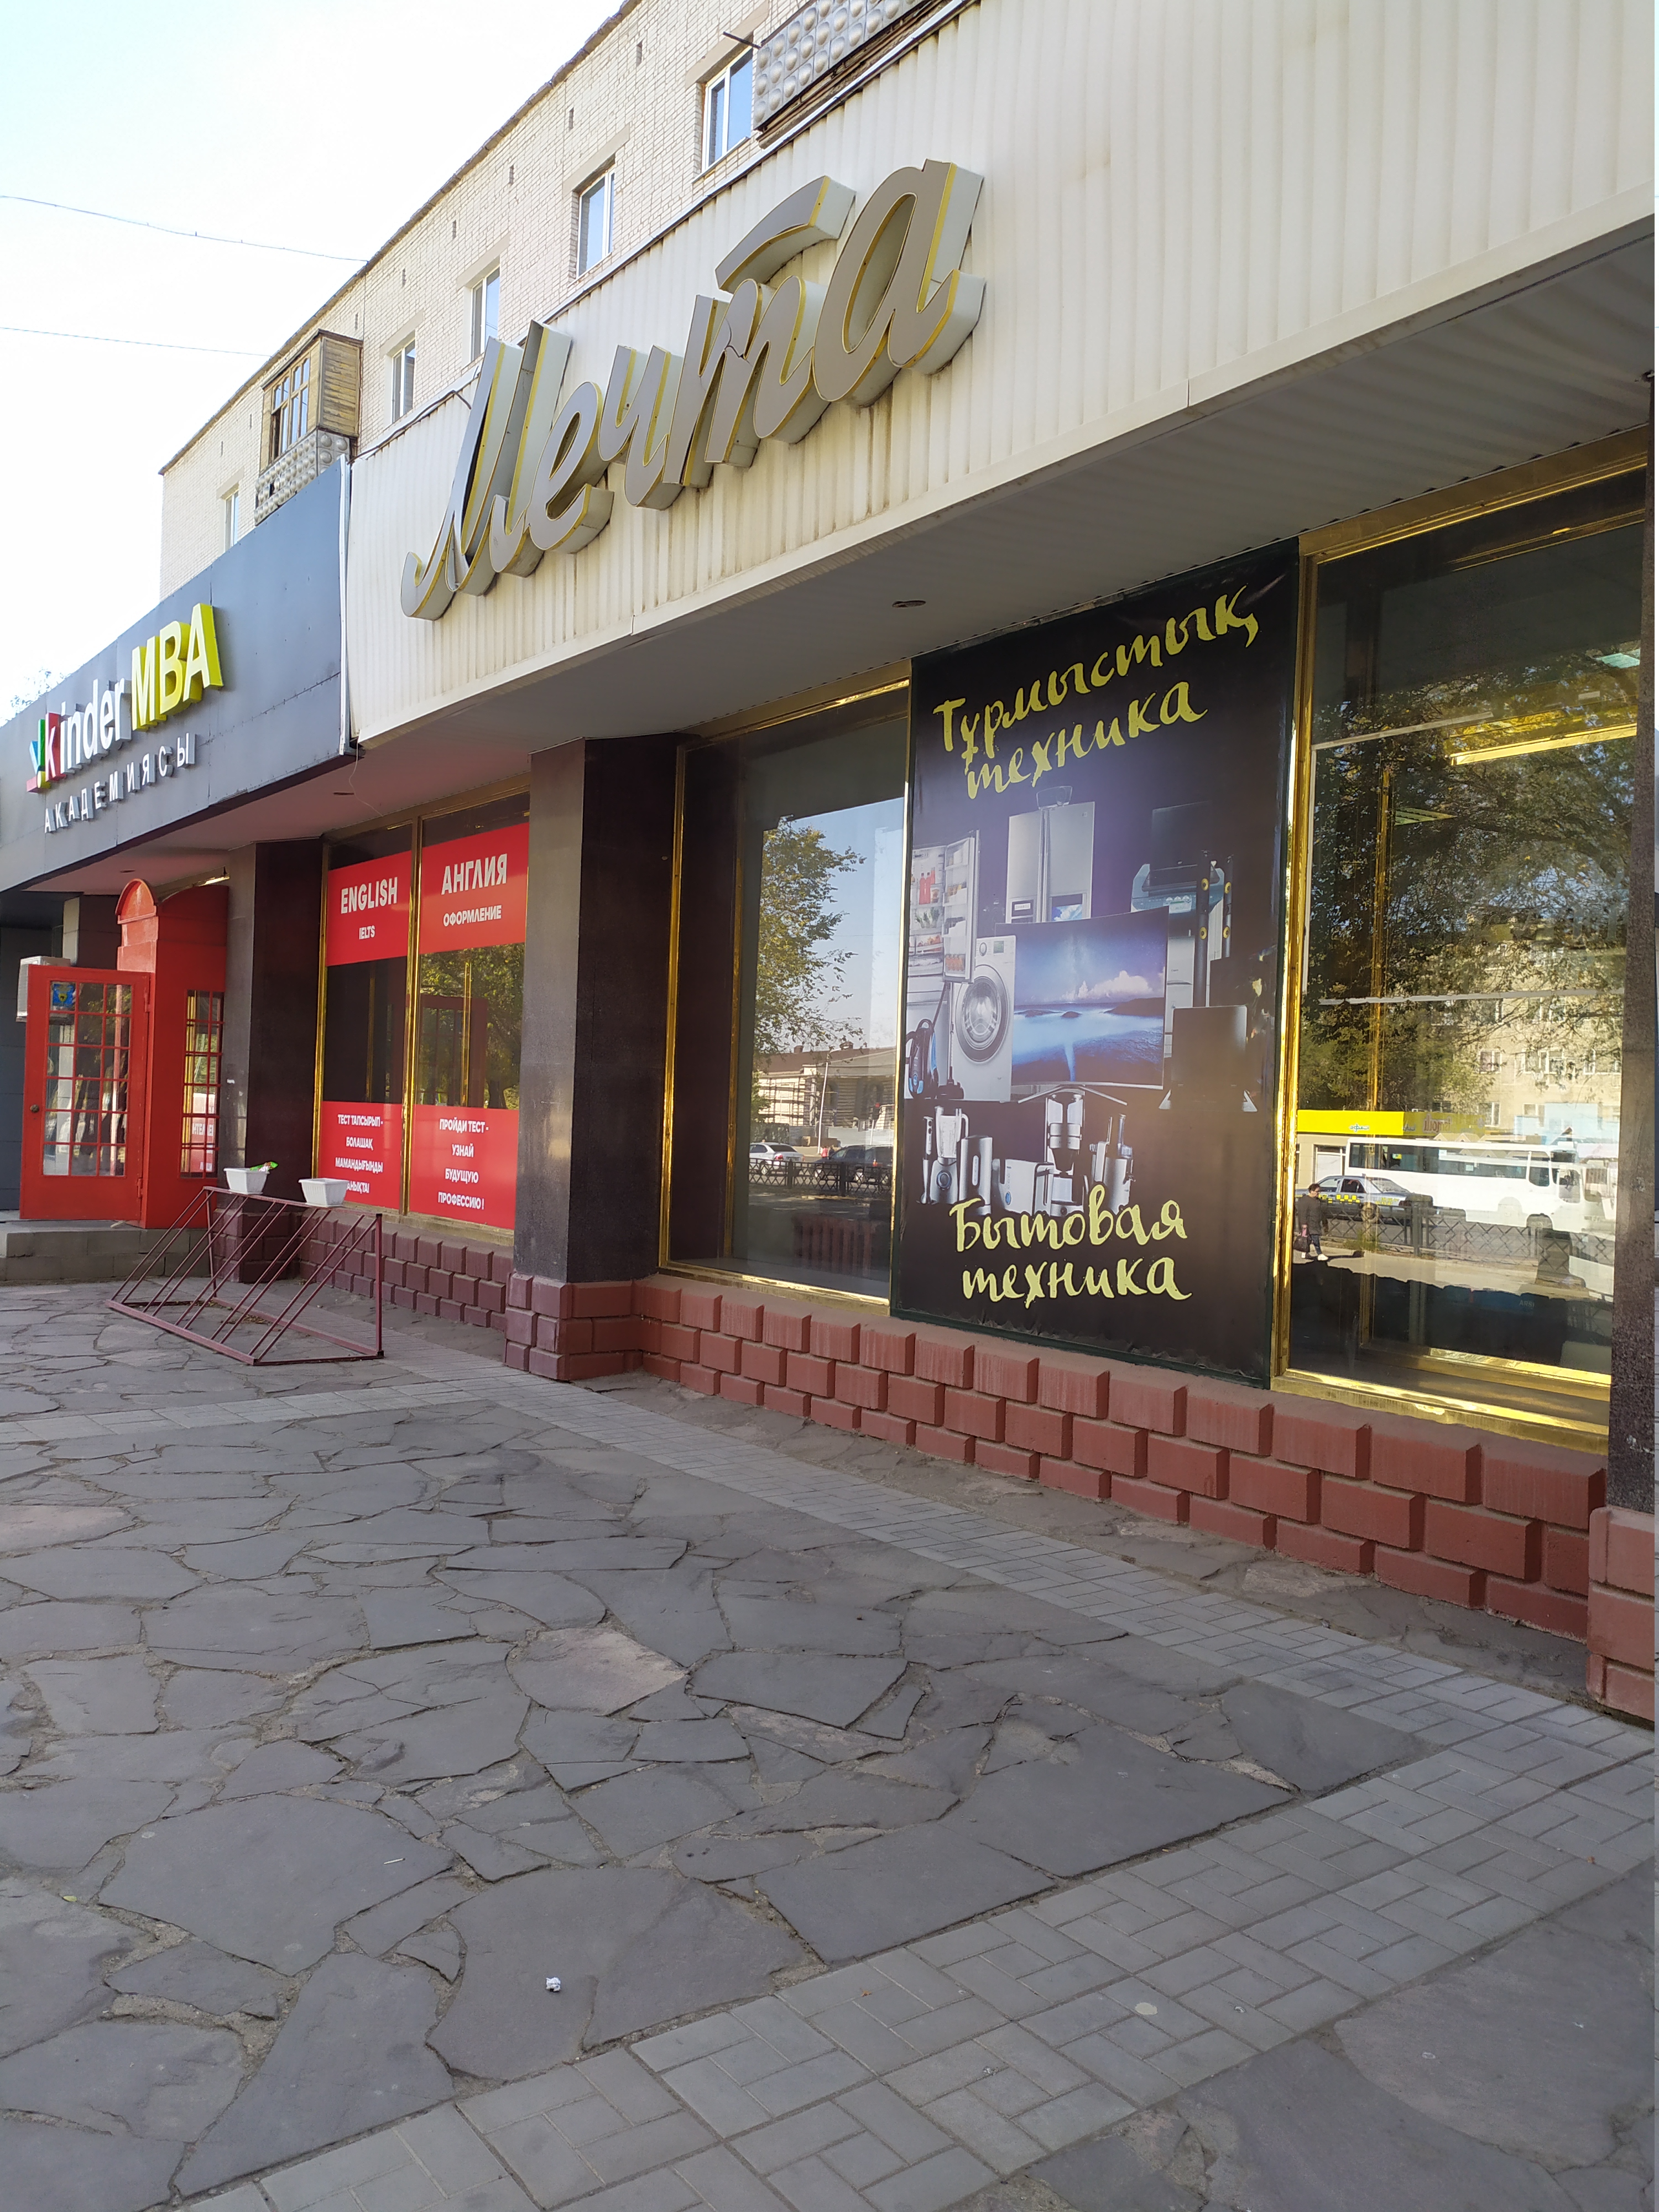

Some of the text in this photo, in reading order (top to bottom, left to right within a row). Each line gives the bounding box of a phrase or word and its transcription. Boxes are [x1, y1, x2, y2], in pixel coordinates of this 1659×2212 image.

[401, 159, 985, 620] Мечта
[933, 585, 1259, 775] Тұрмыстық
[966, 681, 1208, 800] техника
[44, 732, 196, 833] АКАДЕМИЯСЫ
[441, 853, 508, 895] АНГЛИЯ
[341, 877, 398, 914] ENGLISH
[358, 925, 375, 940] IELTS
[443, 905, 502, 927] ОФОРМЛЕНИЕ
[337, 1114, 351, 1125] ТЕСТ
[439, 1117, 467, 1134] ПРОЙДИ
[468, 1120, 486, 1134] ТЕСТ
[346, 1136, 374, 1151] БОЛАШАҚ
[451, 1142, 474, 1158] УЗНАЙ
[445, 1167, 479, 1185] БУДУЩУЮ
[948, 1184, 1188, 1253] Бытовая
[962, 1256, 1192, 1309] техника
